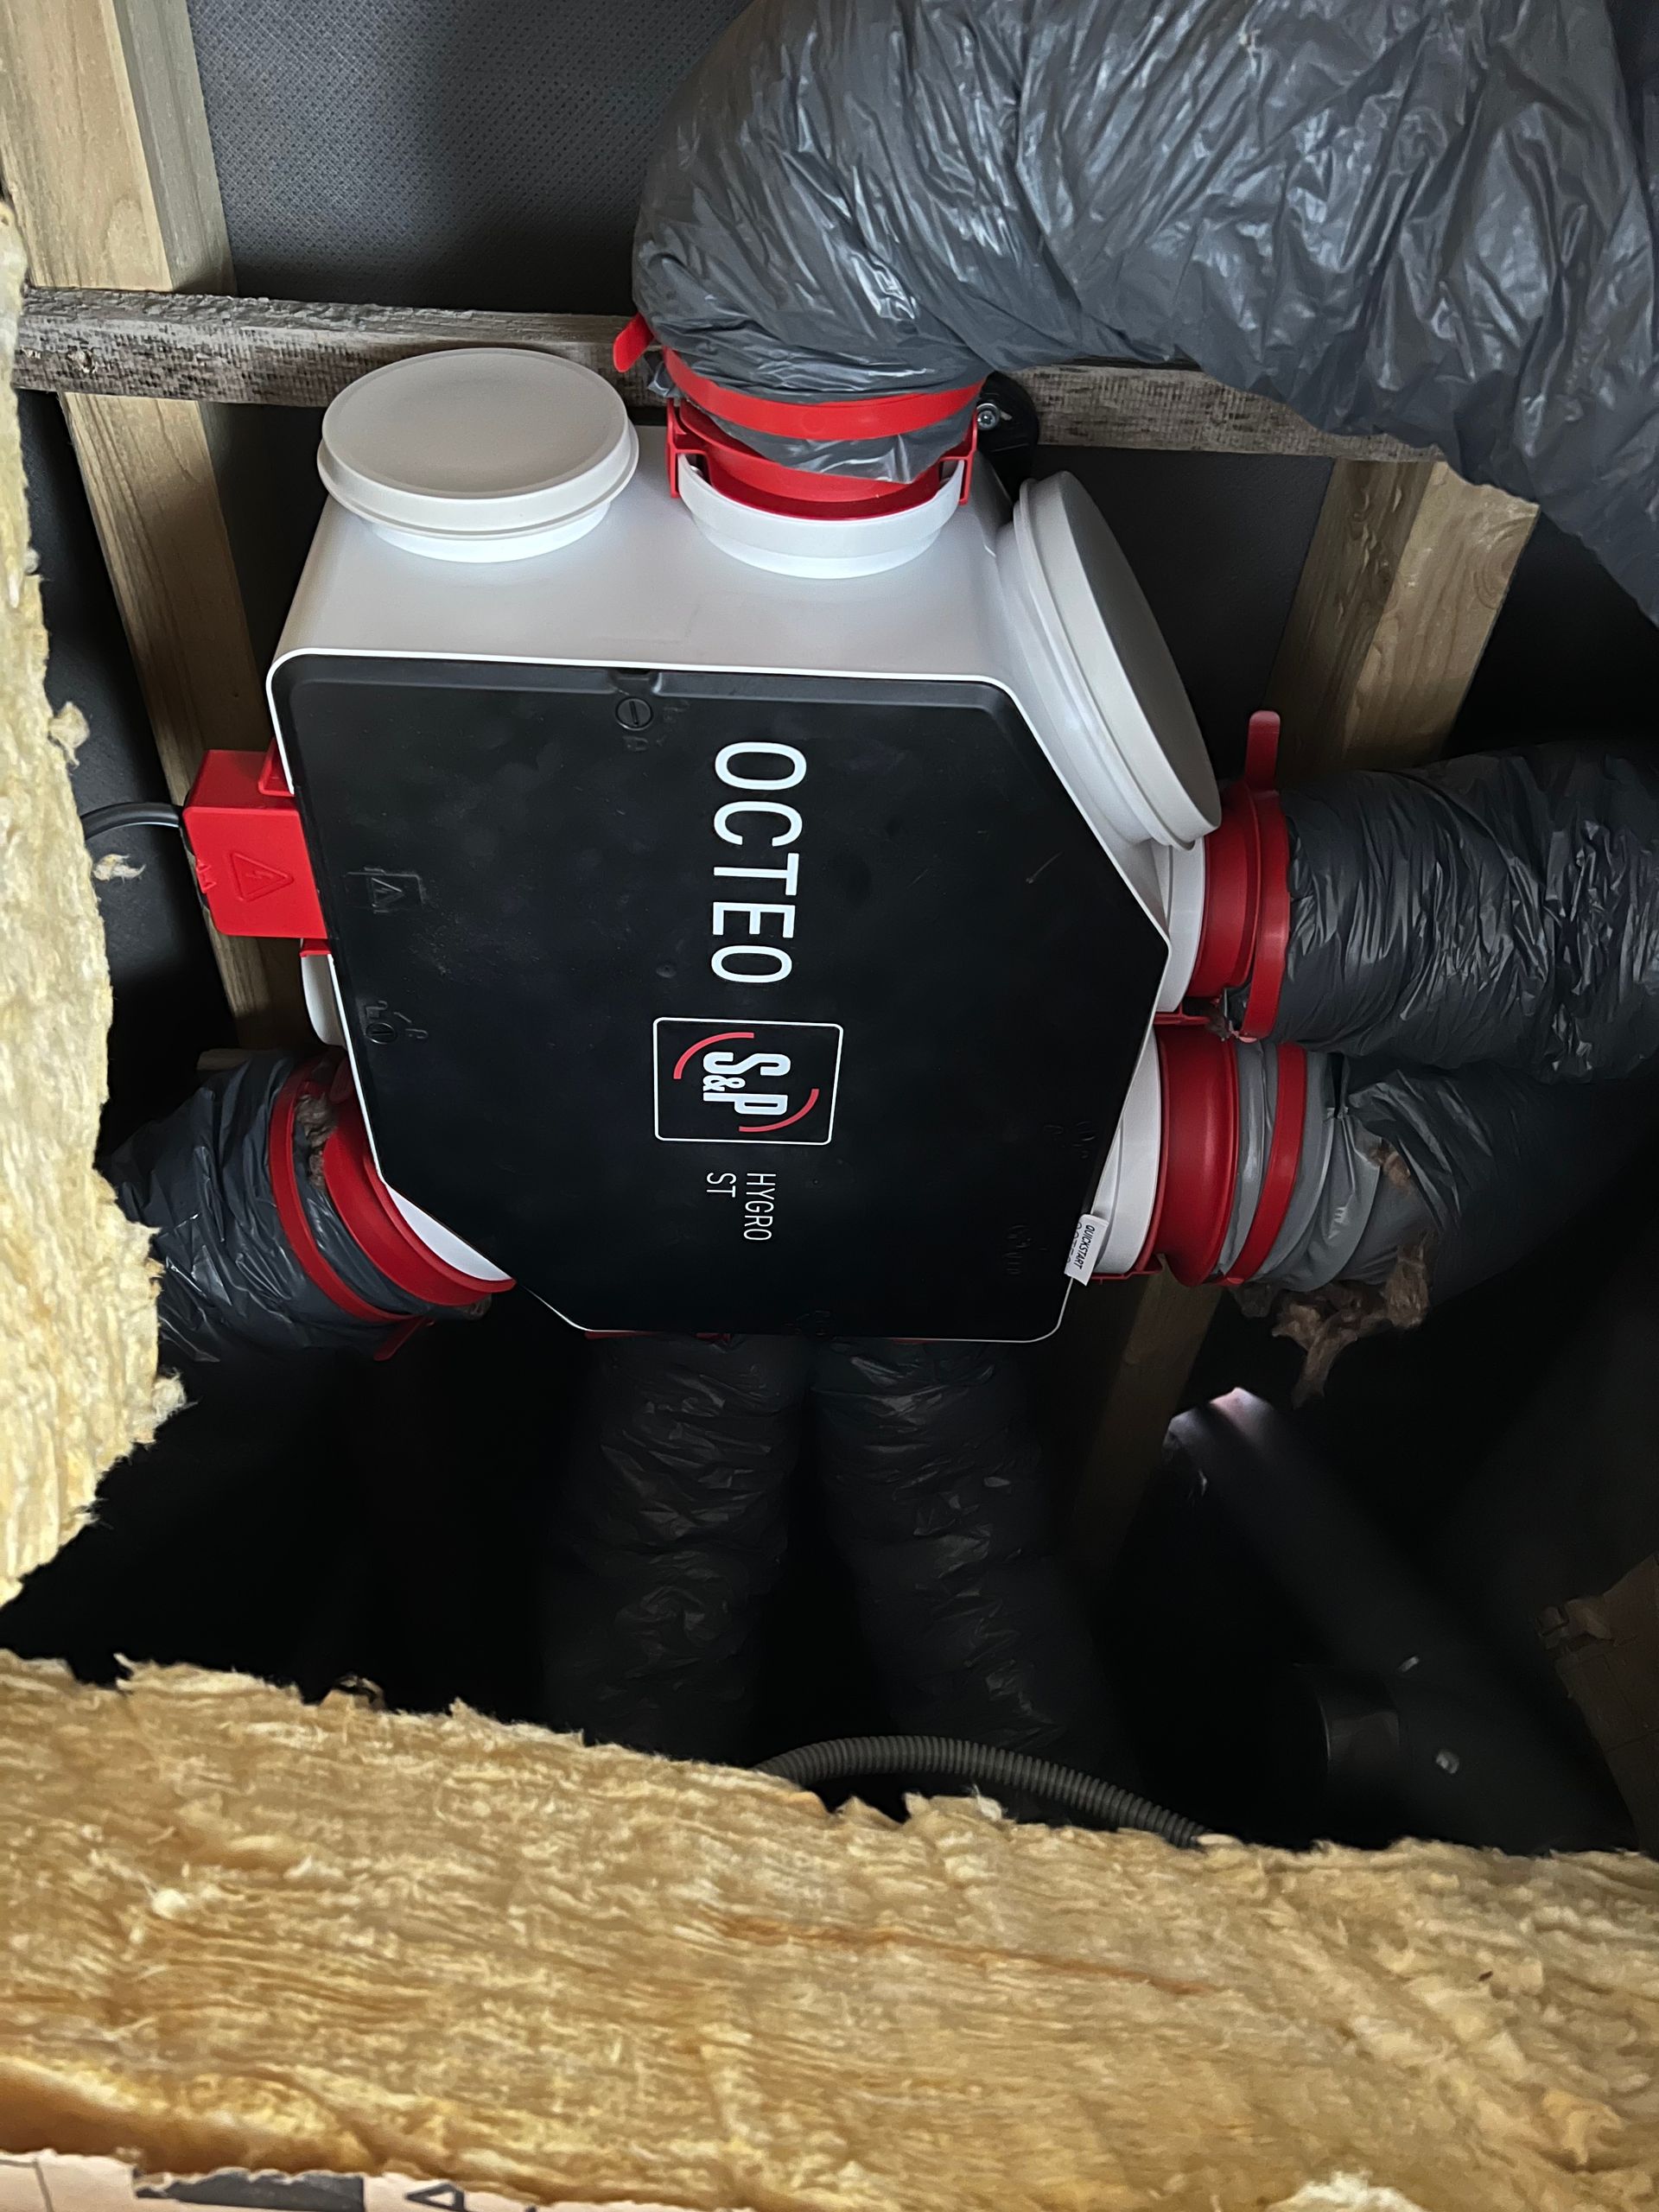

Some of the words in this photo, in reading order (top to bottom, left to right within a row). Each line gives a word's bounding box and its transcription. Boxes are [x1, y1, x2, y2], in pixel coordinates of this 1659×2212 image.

[711, 741, 807, 983] OCTEO
[702, 1052, 791, 1116] S&P
[706, 1172, 737, 1198] ST
[743, 1173, 777, 1241] HYGRO
[1073, 1224, 1096, 1270] QUICKSTART
